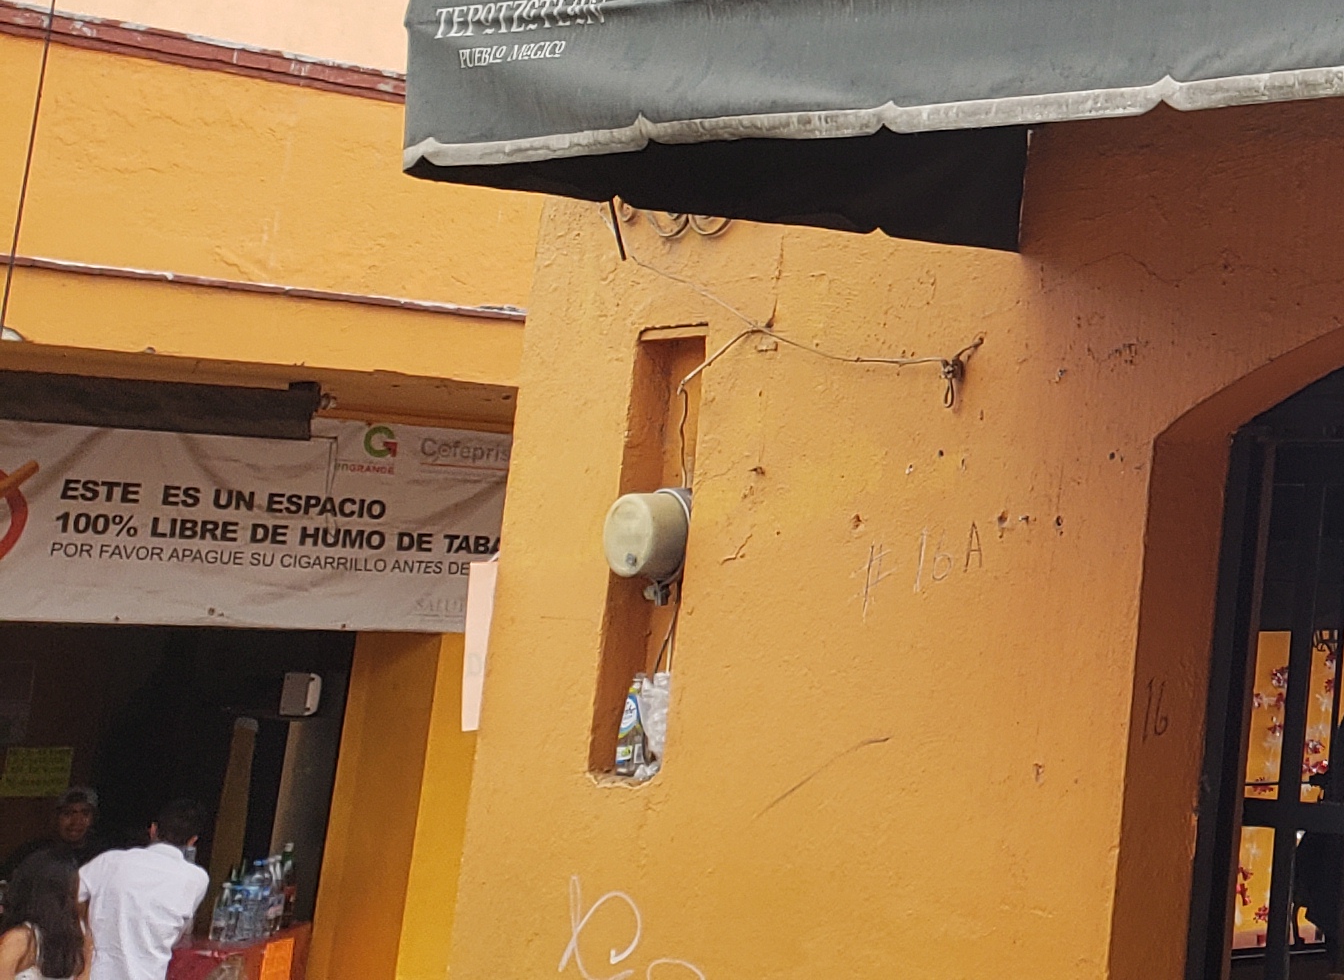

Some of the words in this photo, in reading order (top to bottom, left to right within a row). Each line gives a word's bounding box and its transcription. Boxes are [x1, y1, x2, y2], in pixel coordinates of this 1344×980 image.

[60, 479, 142, 504] ESTE
[161, 485, 201, 508] ES
[212, 489, 255, 511] UN
[266, 492, 387, 520] ESPACIO
[55, 512, 138, 538] 100%
[150, 517, 239, 543] LIBRE
[250, 523, 289, 546] DE
[298, 527, 386, 551] HUMO
[396, 532, 433, 553] DE
[50, 542, 93, 558] POR
[99, 544, 164, 561] FAVOR
[168, 548, 244, 566] APAGUE
[249, 552, 275, 567] SU
[280, 553, 387, 573] CIGARRILLO
[390, 560, 443, 576] ANTES
